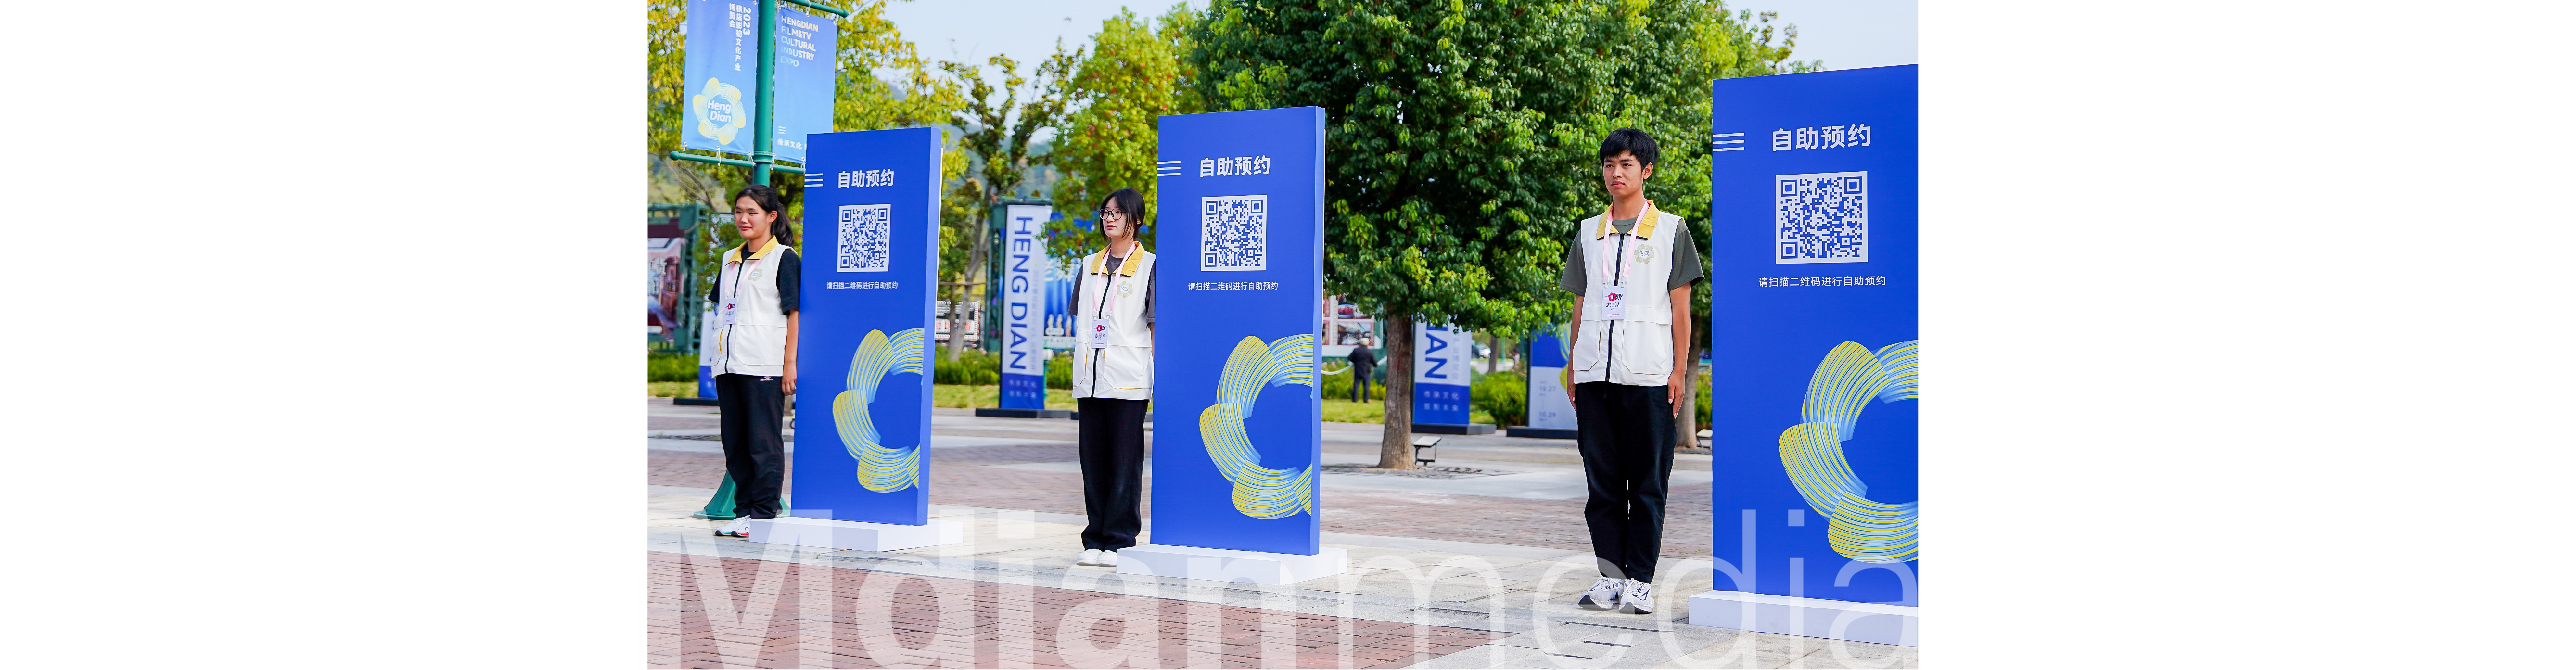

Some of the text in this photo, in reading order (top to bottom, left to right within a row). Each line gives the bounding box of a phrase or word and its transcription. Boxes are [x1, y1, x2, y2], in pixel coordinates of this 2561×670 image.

[743, 6, 751, 36] 2023
[781, 15, 818, 32] HENGDIAN
[781, 35, 816, 51] CULTURAL
[780, 55, 799, 67] EXPO
[781, 46, 814, 61] INDUSTRY
[707, 99, 731, 114] Heng
[709, 110, 731, 123] Dian
[1772, 123, 1871, 152] 自助预约
[1200, 154, 1271, 178] 自助预约
[838, 168, 895, 189] 自助预约
[1011, 216, 1033, 293] HENG
[1187, 281, 1279, 291] 请扫描二维码进行自助预约
[1758, 275, 1886, 288] 请扫描二维码进行自助预约
[1009, 302, 1028, 370] DIAN
[1424, 325, 1449, 379] IAN
